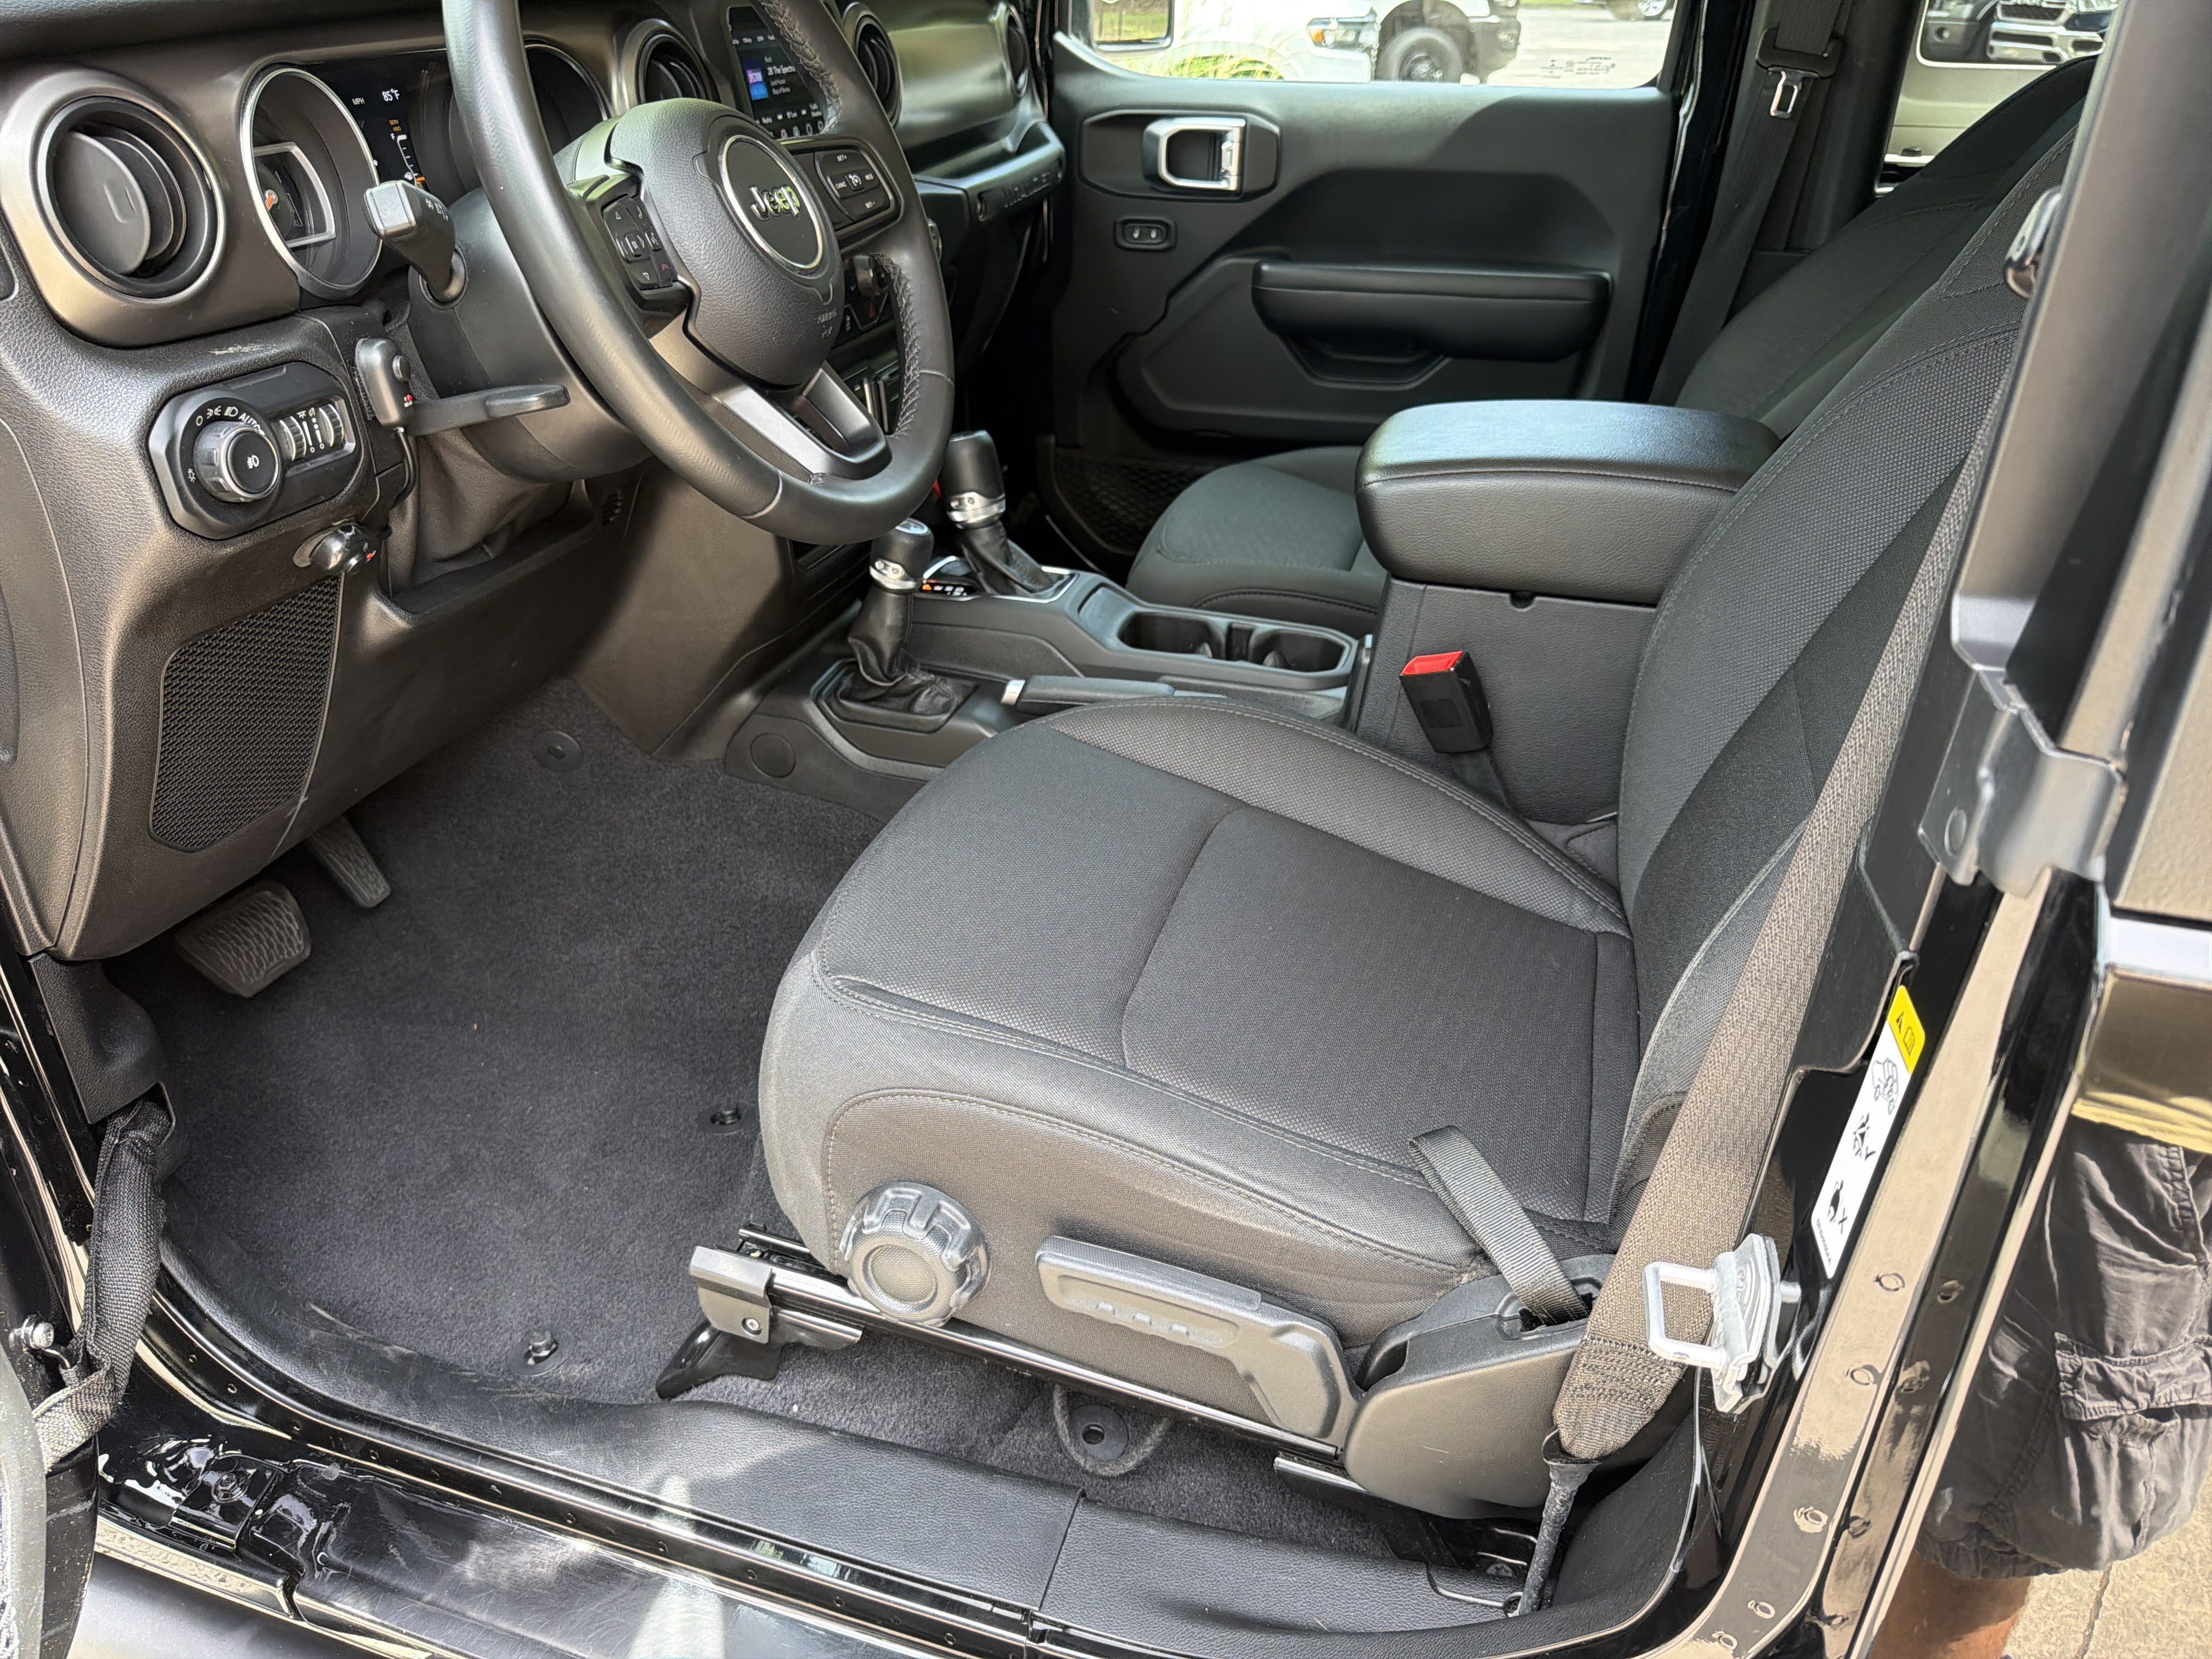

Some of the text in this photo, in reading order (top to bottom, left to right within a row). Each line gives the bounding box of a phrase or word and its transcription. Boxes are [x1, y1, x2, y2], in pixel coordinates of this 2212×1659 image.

[352, 97, 365, 105] MPH
[382, 88, 400, 101] 85°F
[749, 186, 800, 221] Jeep
